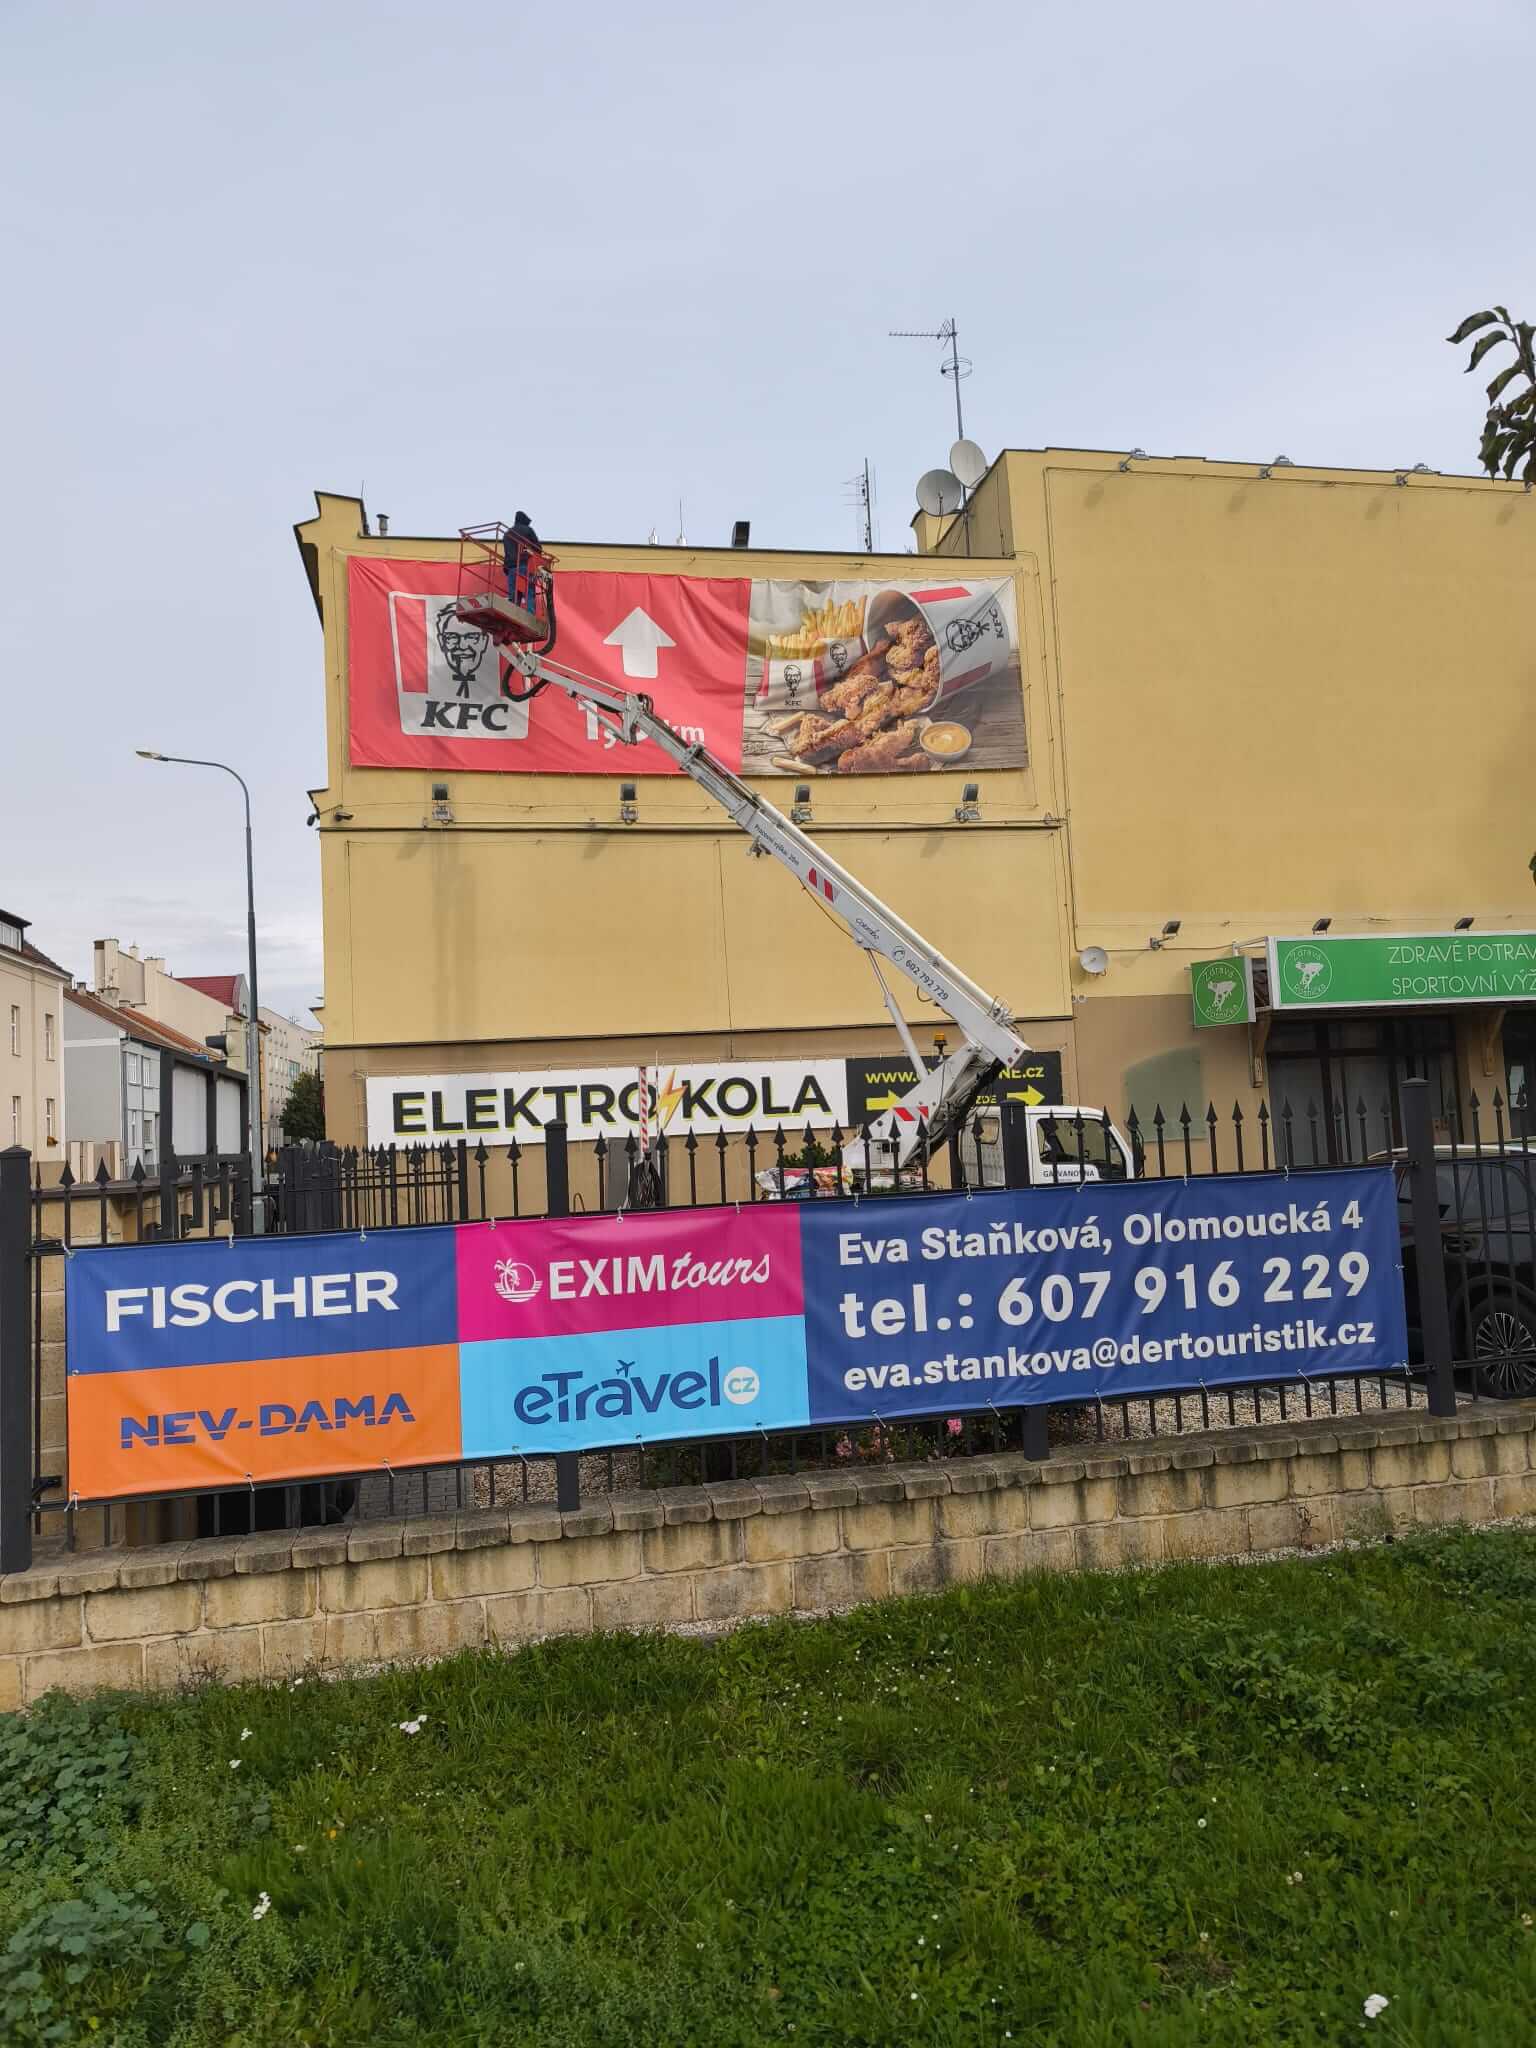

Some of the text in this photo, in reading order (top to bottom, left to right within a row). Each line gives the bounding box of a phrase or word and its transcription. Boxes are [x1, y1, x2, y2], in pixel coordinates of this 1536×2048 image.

[421, 701, 509, 731] KFC
[577, 700, 649, 749] 1,
[1386, 940, 1463, 964] ZDRAVÉ
[905, 960, 949, 1001] 602 792 729
[1392, 969, 1498, 995] SPORTOVNÍ
[838, 1199, 1364, 1266] Eva Staňková, Olomoucká 4
[105, 1270, 400, 1332] FISCHER
[839, 1251, 1370, 1338] tel.: 607 916 229
[844, 1320, 1376, 1391] eva.stankova@dertouristik.cz
[121, 1392, 415, 1448] NEV-DAMA
